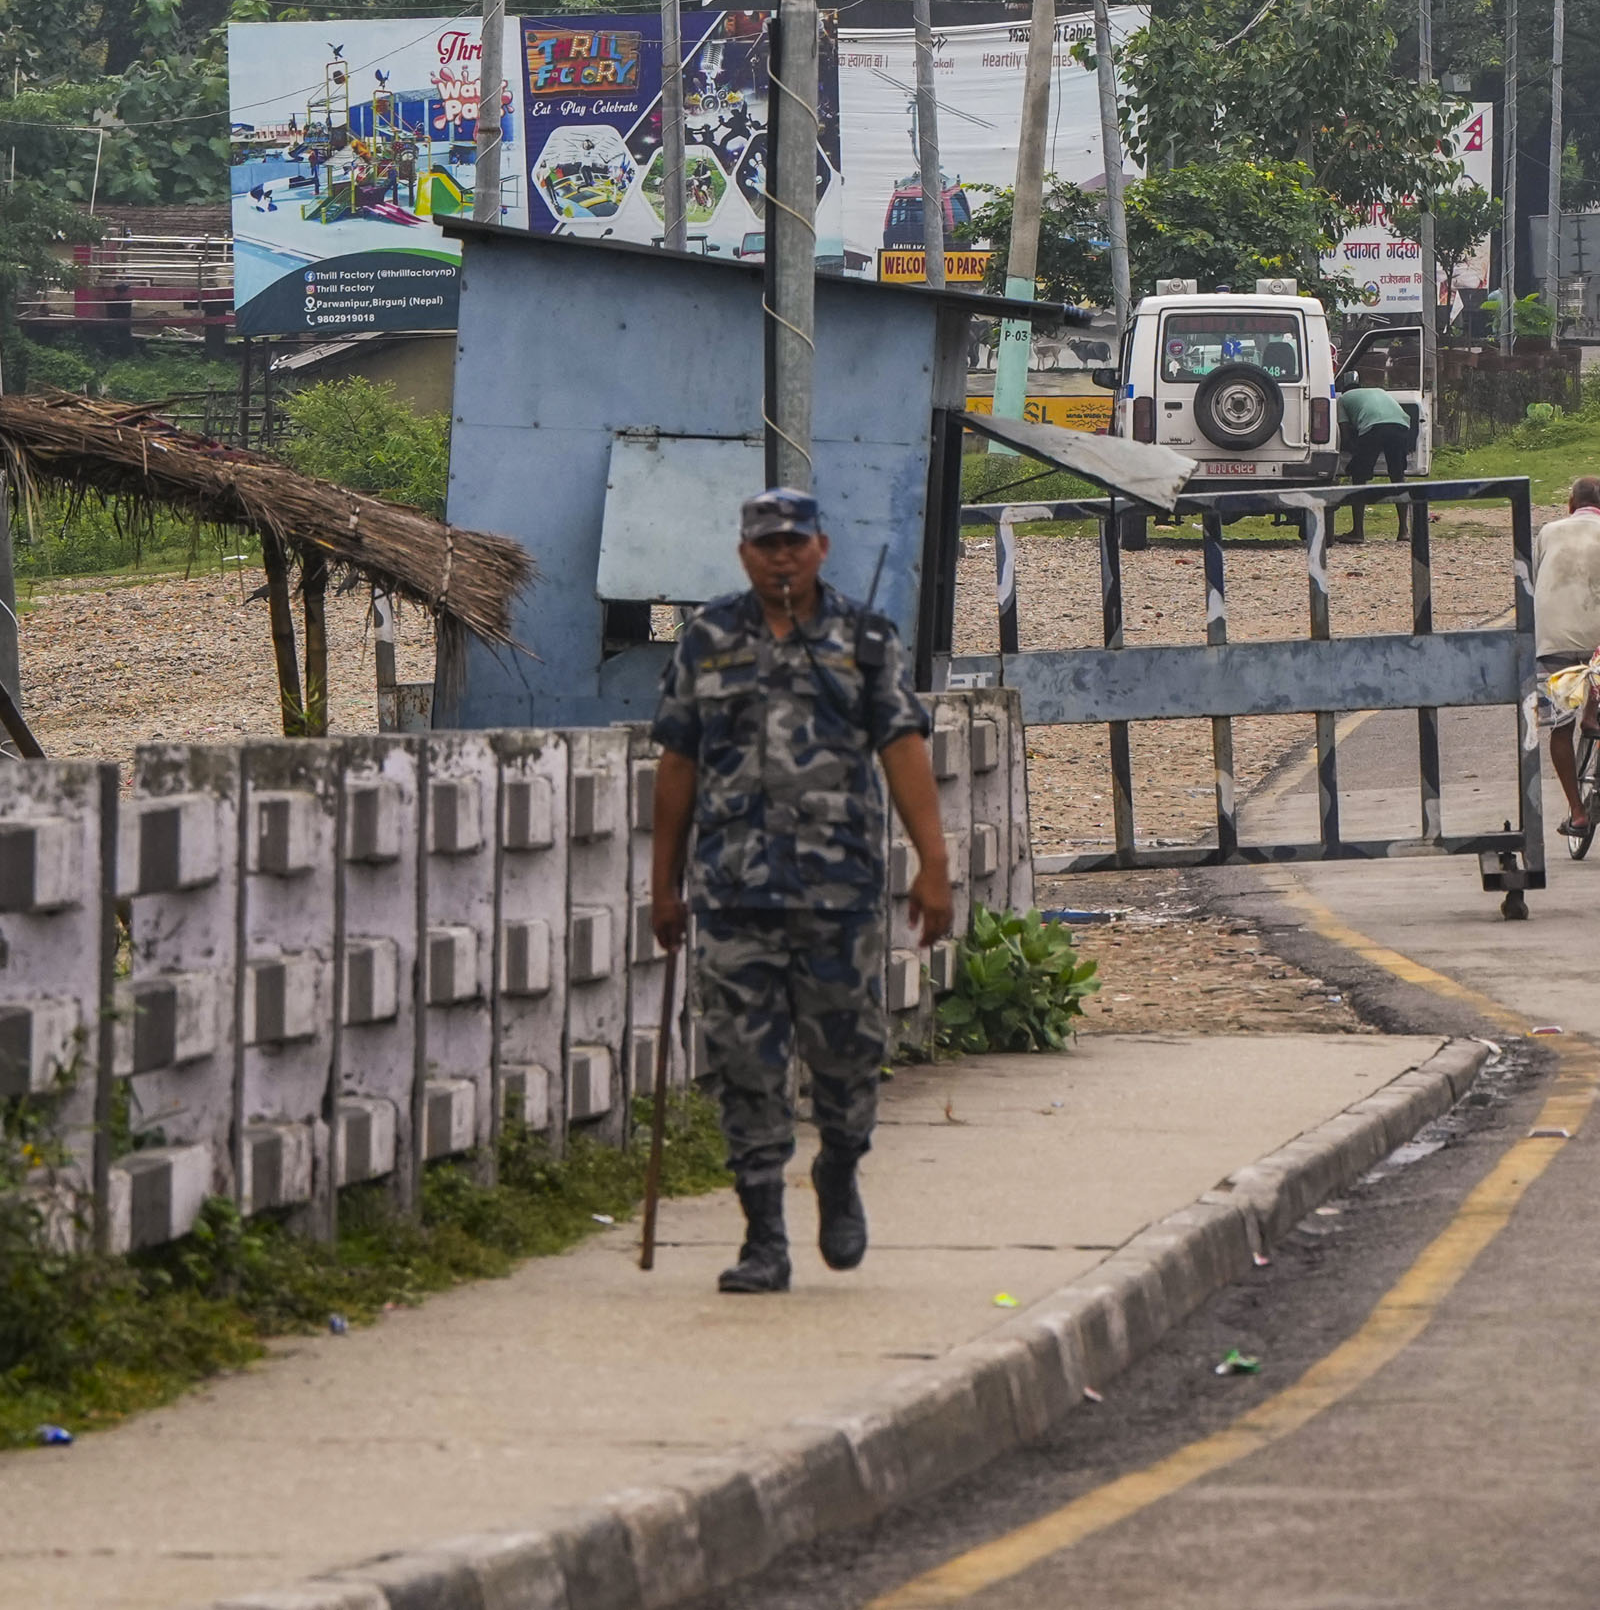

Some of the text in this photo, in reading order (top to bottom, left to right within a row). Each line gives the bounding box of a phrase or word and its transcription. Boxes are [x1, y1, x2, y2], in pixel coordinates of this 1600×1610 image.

[1063, 22, 1093, 42] Cable
[538, 34, 623, 64] THRILL
[982, 51, 1021, 71] Heartily
[532, 99, 638, 117] Eat Play Celebrate
[1343, 243, 1381, 260] स्वागत
[956, 256, 991, 275] PARS
[316, 272, 337, 280] Thrill
[340, 271, 375, 281] Factory
[316, 285, 375, 294] Thrill Factory
[409, 296, 444, 307] (Nepal)
[317, 314, 375, 323] 9802919018
